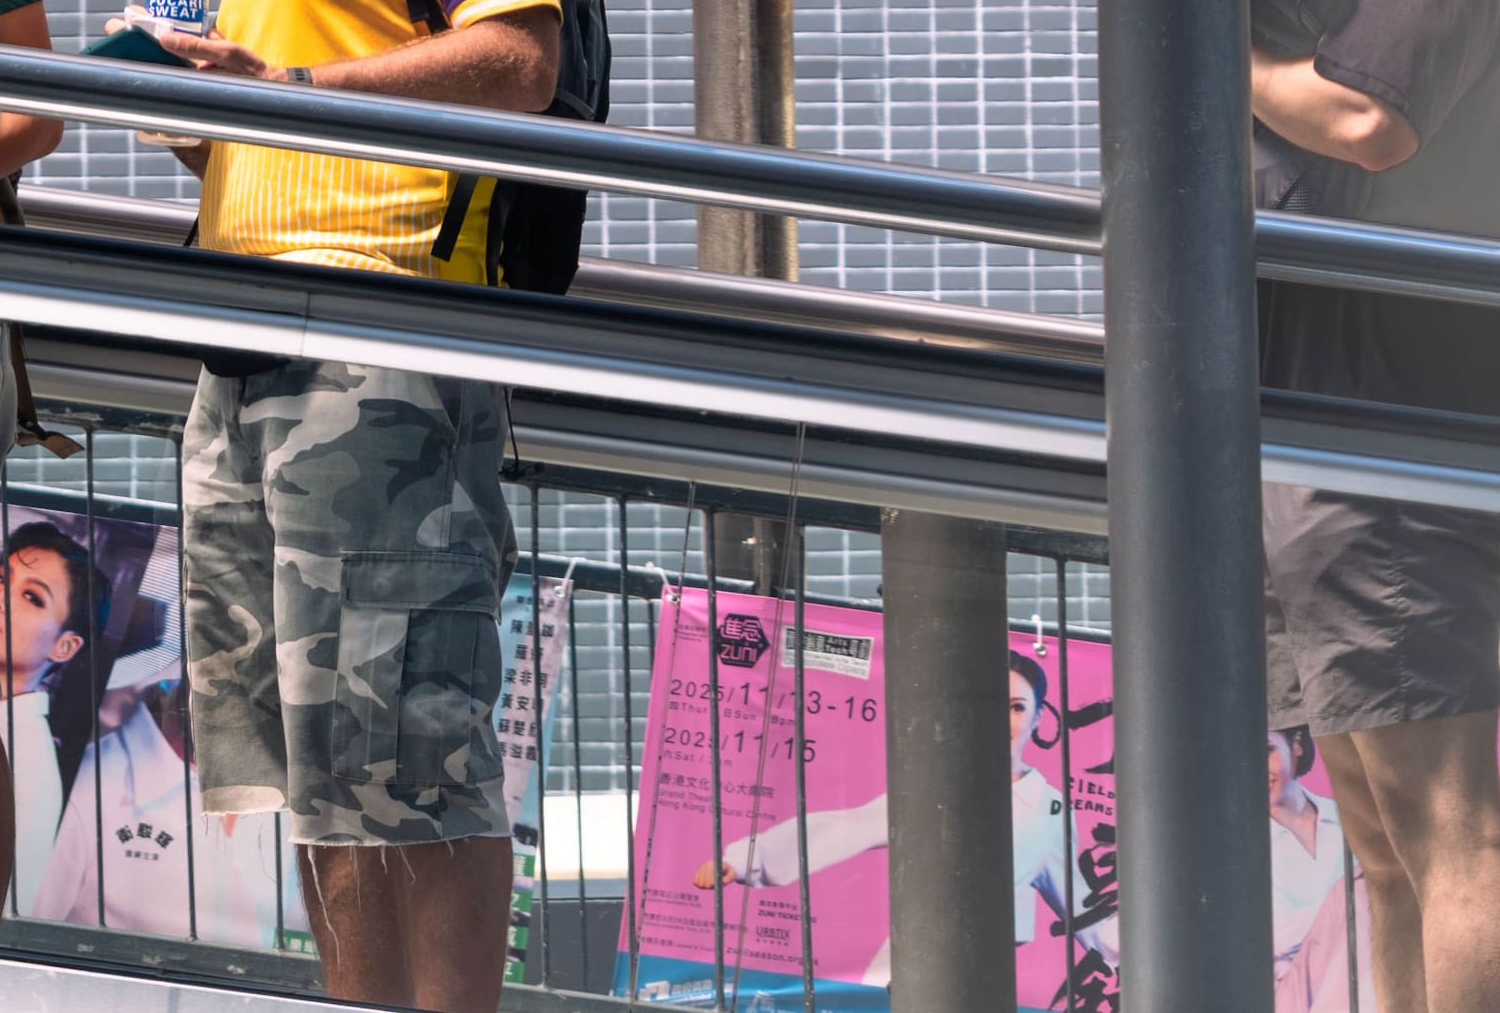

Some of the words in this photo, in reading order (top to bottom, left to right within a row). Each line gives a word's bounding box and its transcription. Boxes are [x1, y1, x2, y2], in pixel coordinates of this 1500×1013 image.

[149, 6, 198, 19] SWEAT
[664, 727, 817, 763] 202/11/15
[659, 771, 775, 799] 香港文化心大劇院
[1050, 799, 1114, 816] DEAMS
